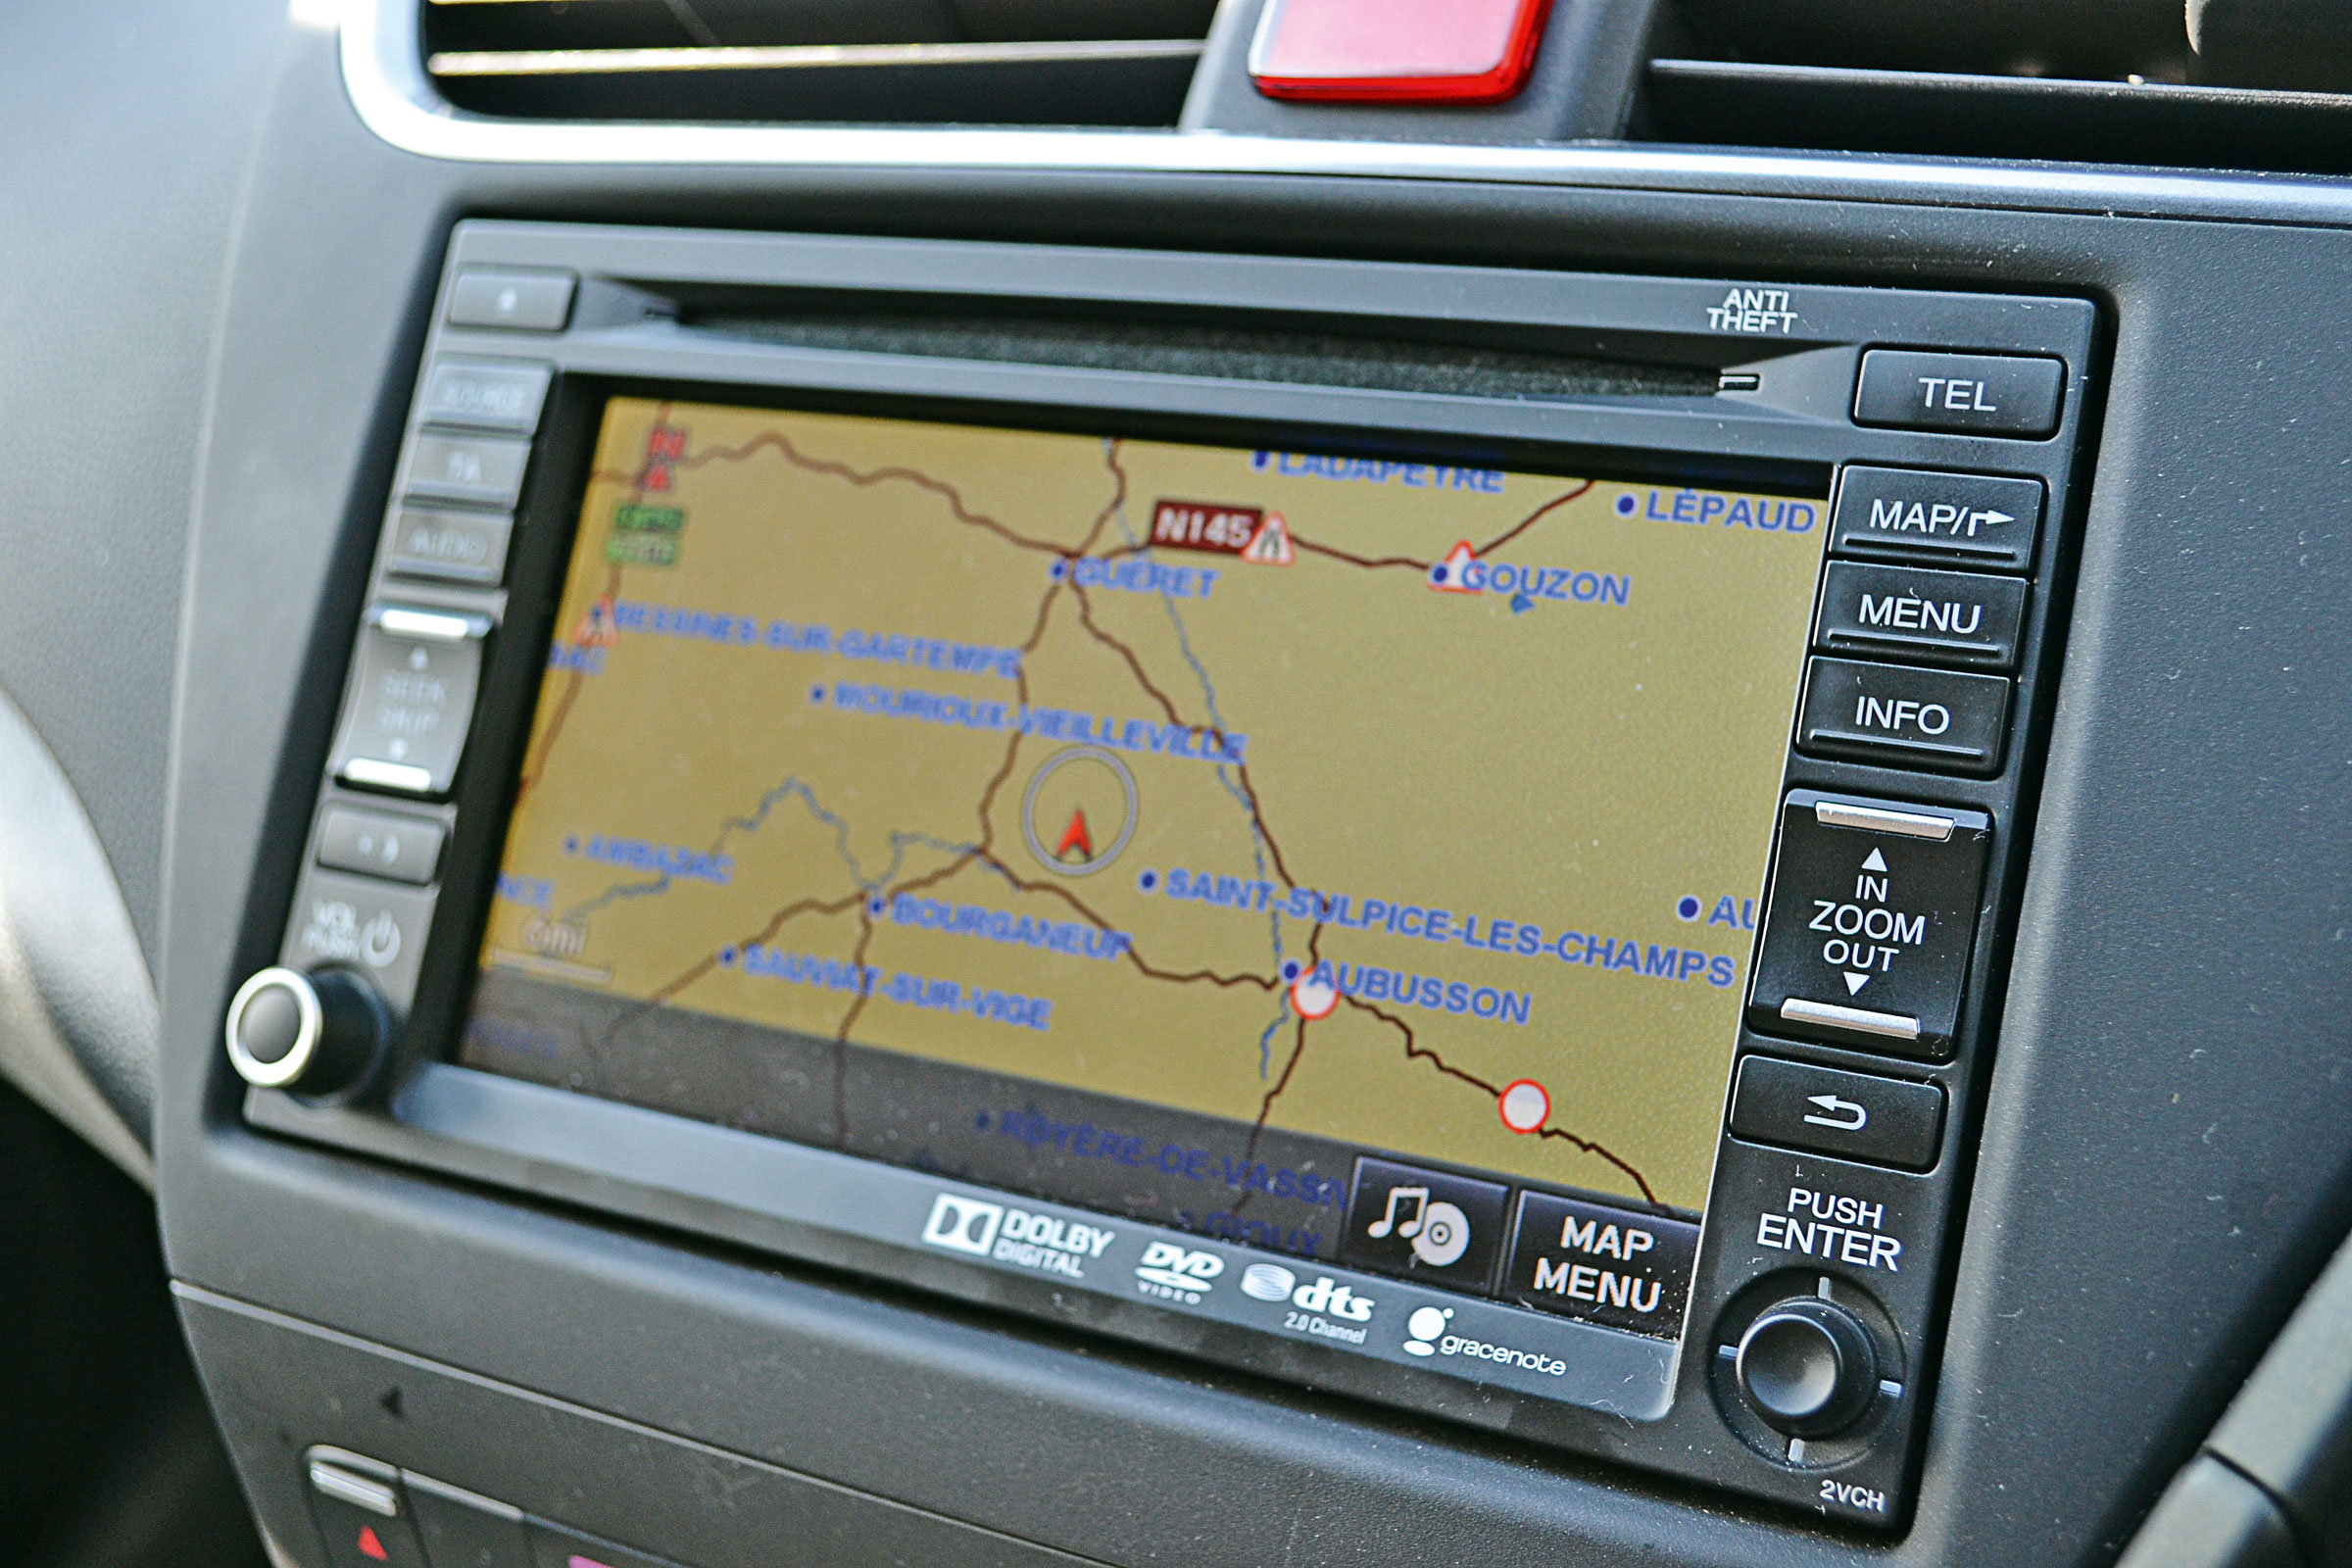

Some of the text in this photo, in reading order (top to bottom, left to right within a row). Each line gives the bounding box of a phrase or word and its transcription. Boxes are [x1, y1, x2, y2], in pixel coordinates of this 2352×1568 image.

[1706, 307, 1798, 334] THEFT
[1723, 288, 1789, 311] ANTI
[1918, 376, 1996, 413] TEL
[1155, 506, 1254, 549] N145
[1461, 560, 1631, 608] GOUZON
[1858, 593, 1981, 634] MENU
[1855, 696, 1950, 735] INFO
[1855, 874, 1888, 903] IN
[1166, 868, 1737, 990] SAINT-SULPICE-LES-CHAMPS
[1809, 900, 1927, 945] ZOOM
[1823, 939, 1900, 972] OUT
[1309, 958, 1532, 1026] AUBUSSON
[1787, 1187, 1884, 1230] PUSH
[1002, 1208, 1115, 1258] DOLBY
[1560, 1215, 1654, 1261] MAP
[1756, 1212, 1903, 1272] ENTER
[992, 1239, 1085, 1279] DIGITAL
[1140, 1240, 1225, 1279] DVD
[1137, 1279, 1202, 1305] VIDEO
[1293, 1276, 1376, 1323] dts
[1533, 1257, 1662, 1313] MENU
[1284, 1310, 1368, 1346] 2.0 Channel
[1438, 1334, 1568, 1377] gracenote
[1820, 1478, 1887, 1514] 2VCH
